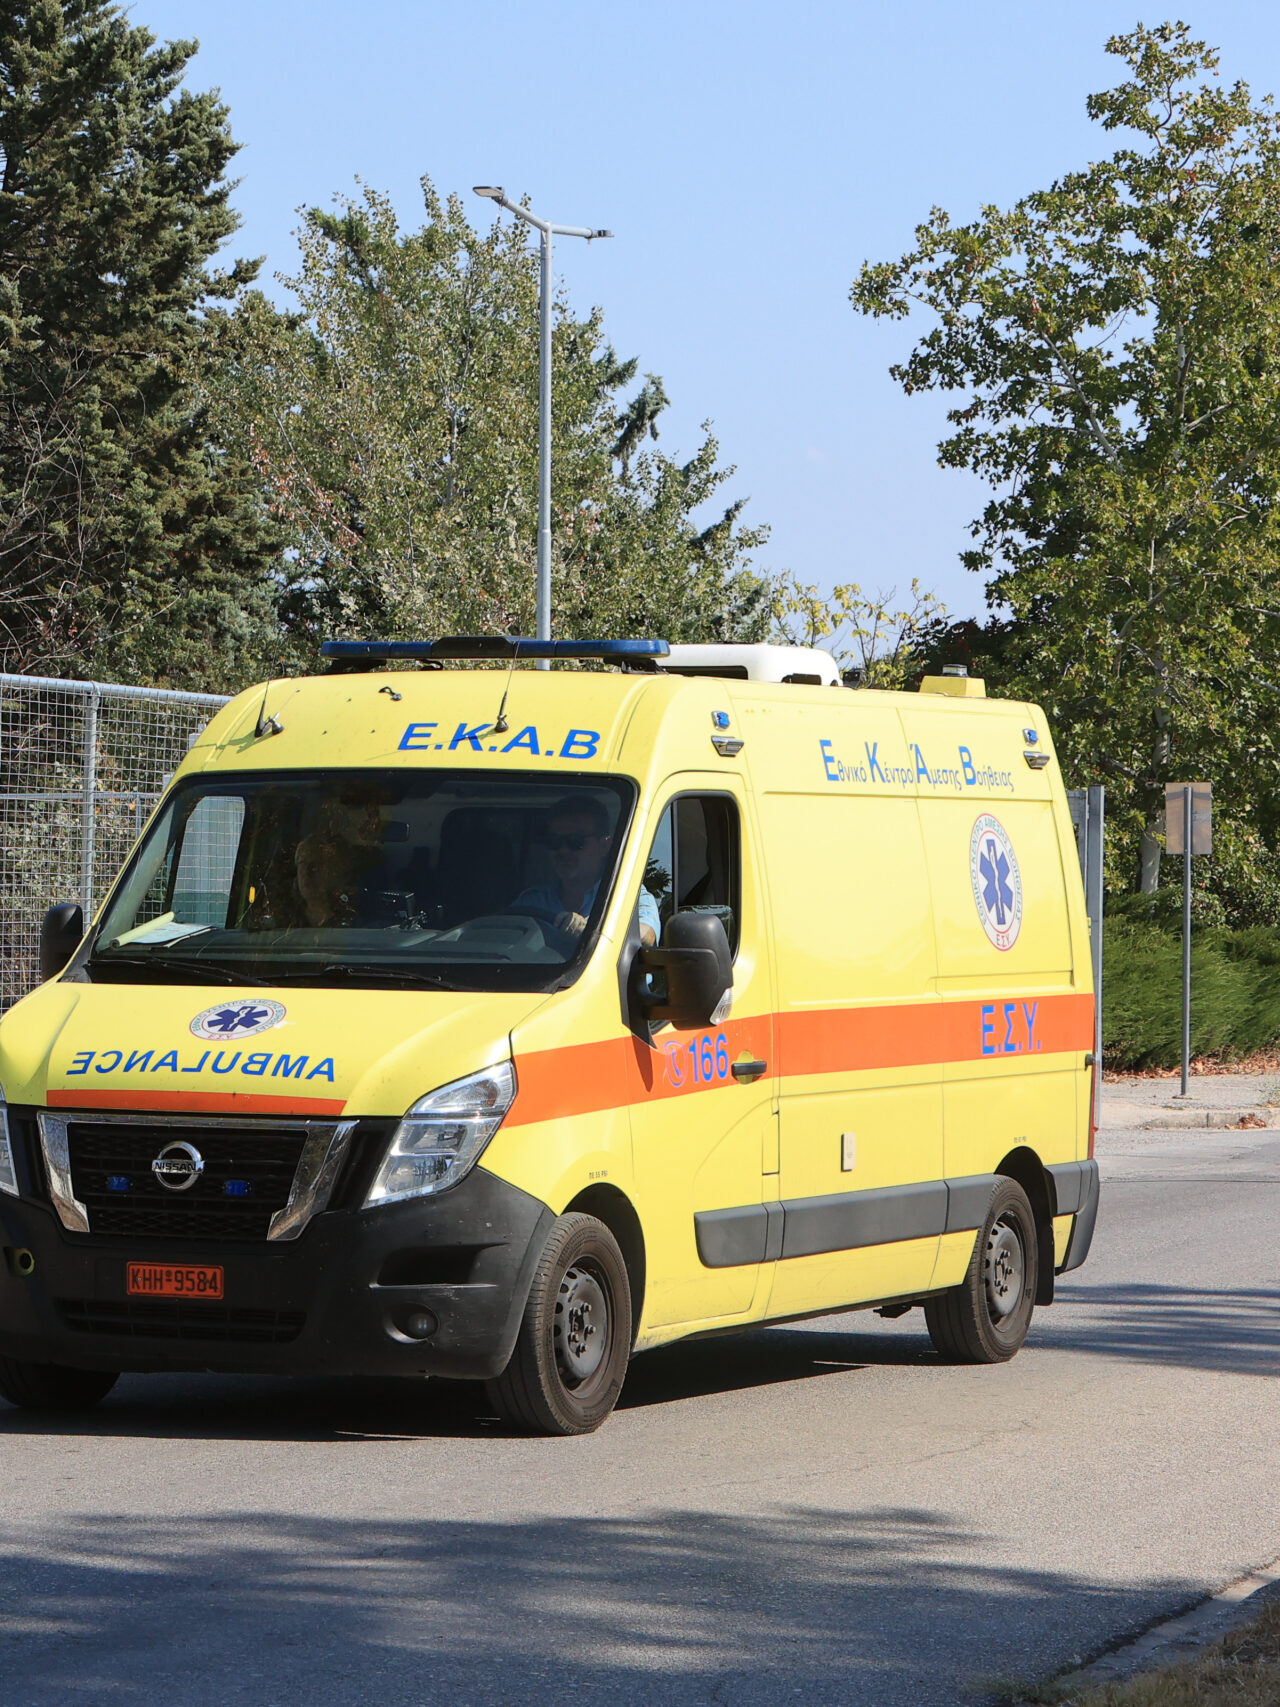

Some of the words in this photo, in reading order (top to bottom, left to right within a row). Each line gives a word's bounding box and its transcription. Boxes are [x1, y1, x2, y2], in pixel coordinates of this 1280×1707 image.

[397, 722, 601, 760] Ε.Κ.Α.Β
[819, 739, 867, 783] Εθνικό
[864, 741, 914, 789] Κέντρο
[909, 743, 963, 791] Άμεσης
[958, 745, 1015, 793] Βοήθειας
[982, 1002, 1040, 1055] Ε.Σ.Υ.
[688, 1033, 728, 1082] 166
[154, 1161, 197, 1172] NISSAN
